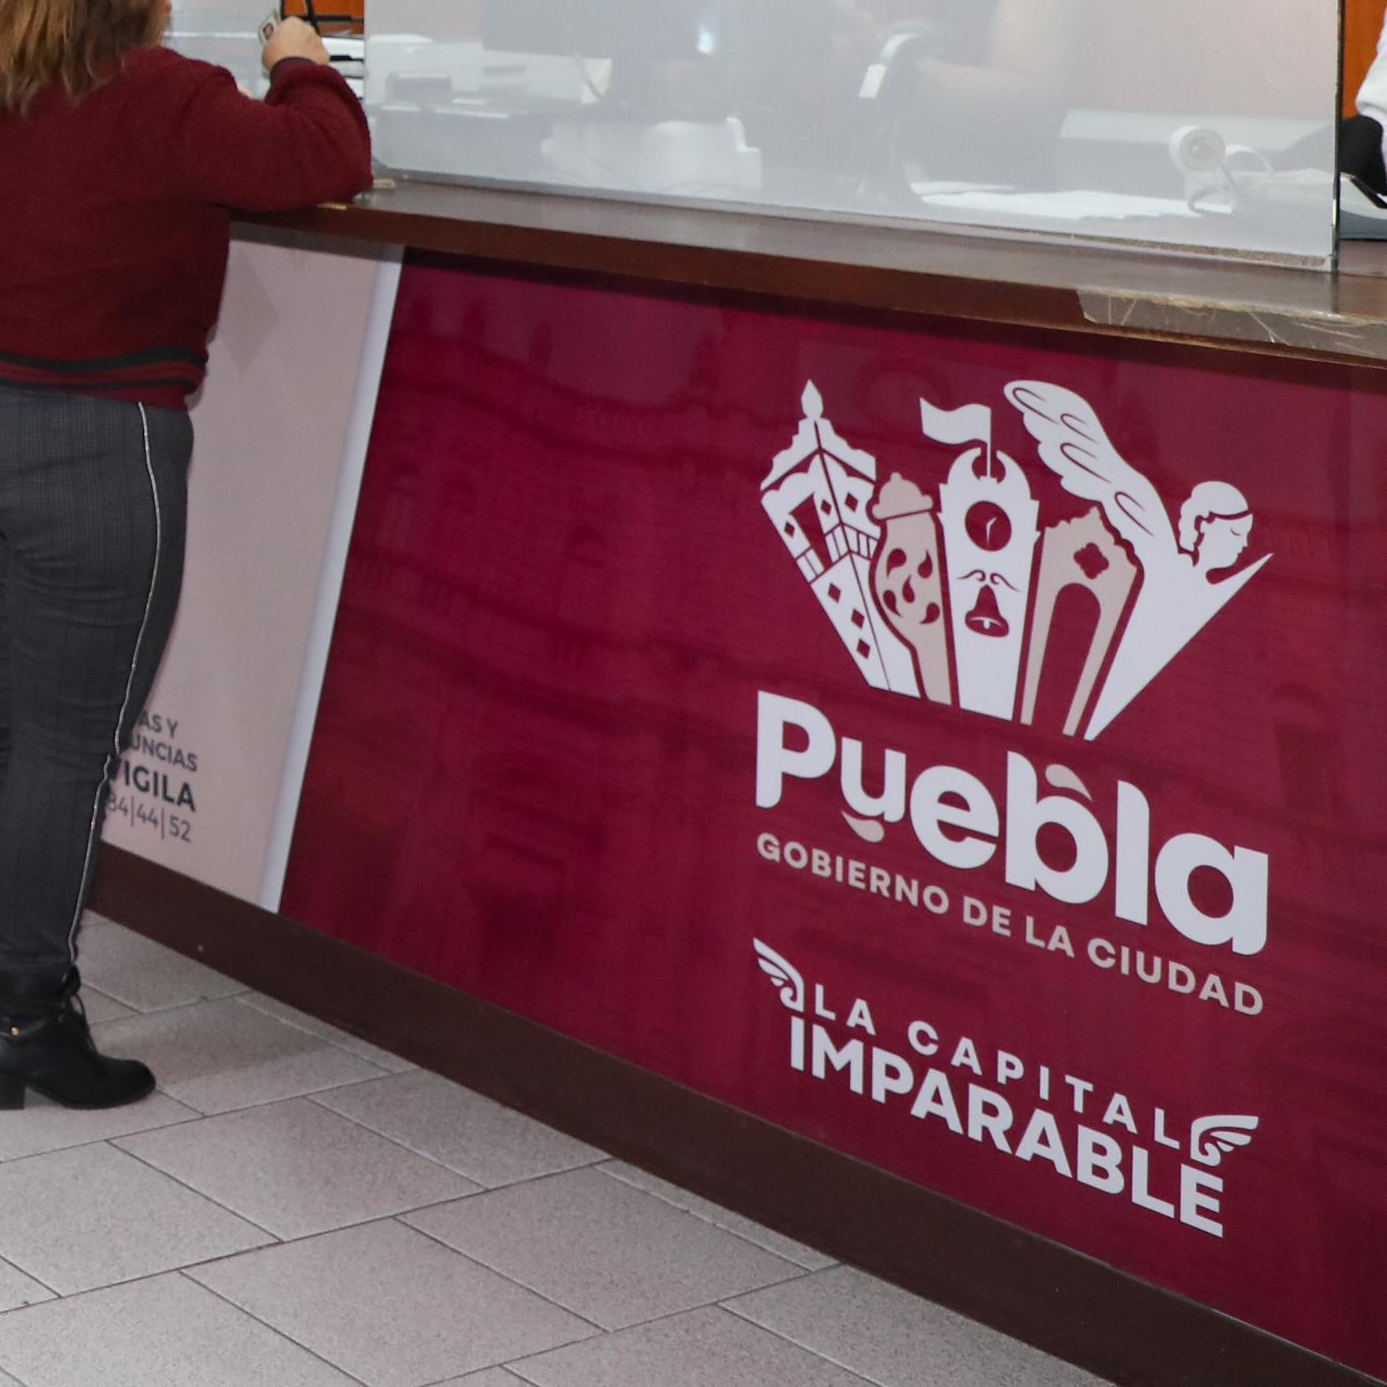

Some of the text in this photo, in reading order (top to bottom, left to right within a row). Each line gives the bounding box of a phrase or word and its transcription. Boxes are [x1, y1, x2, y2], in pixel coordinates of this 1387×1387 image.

[166, 716, 178, 739] Y
[755, 690, 1269, 957] Puebla
[756, 832, 1264, 1016] GOBIERNO DE LA CIUDAD
[790, 1015, 1224, 1238] IMPARABLE
[814, 983, 1181, 1150] LA CAPITAL
